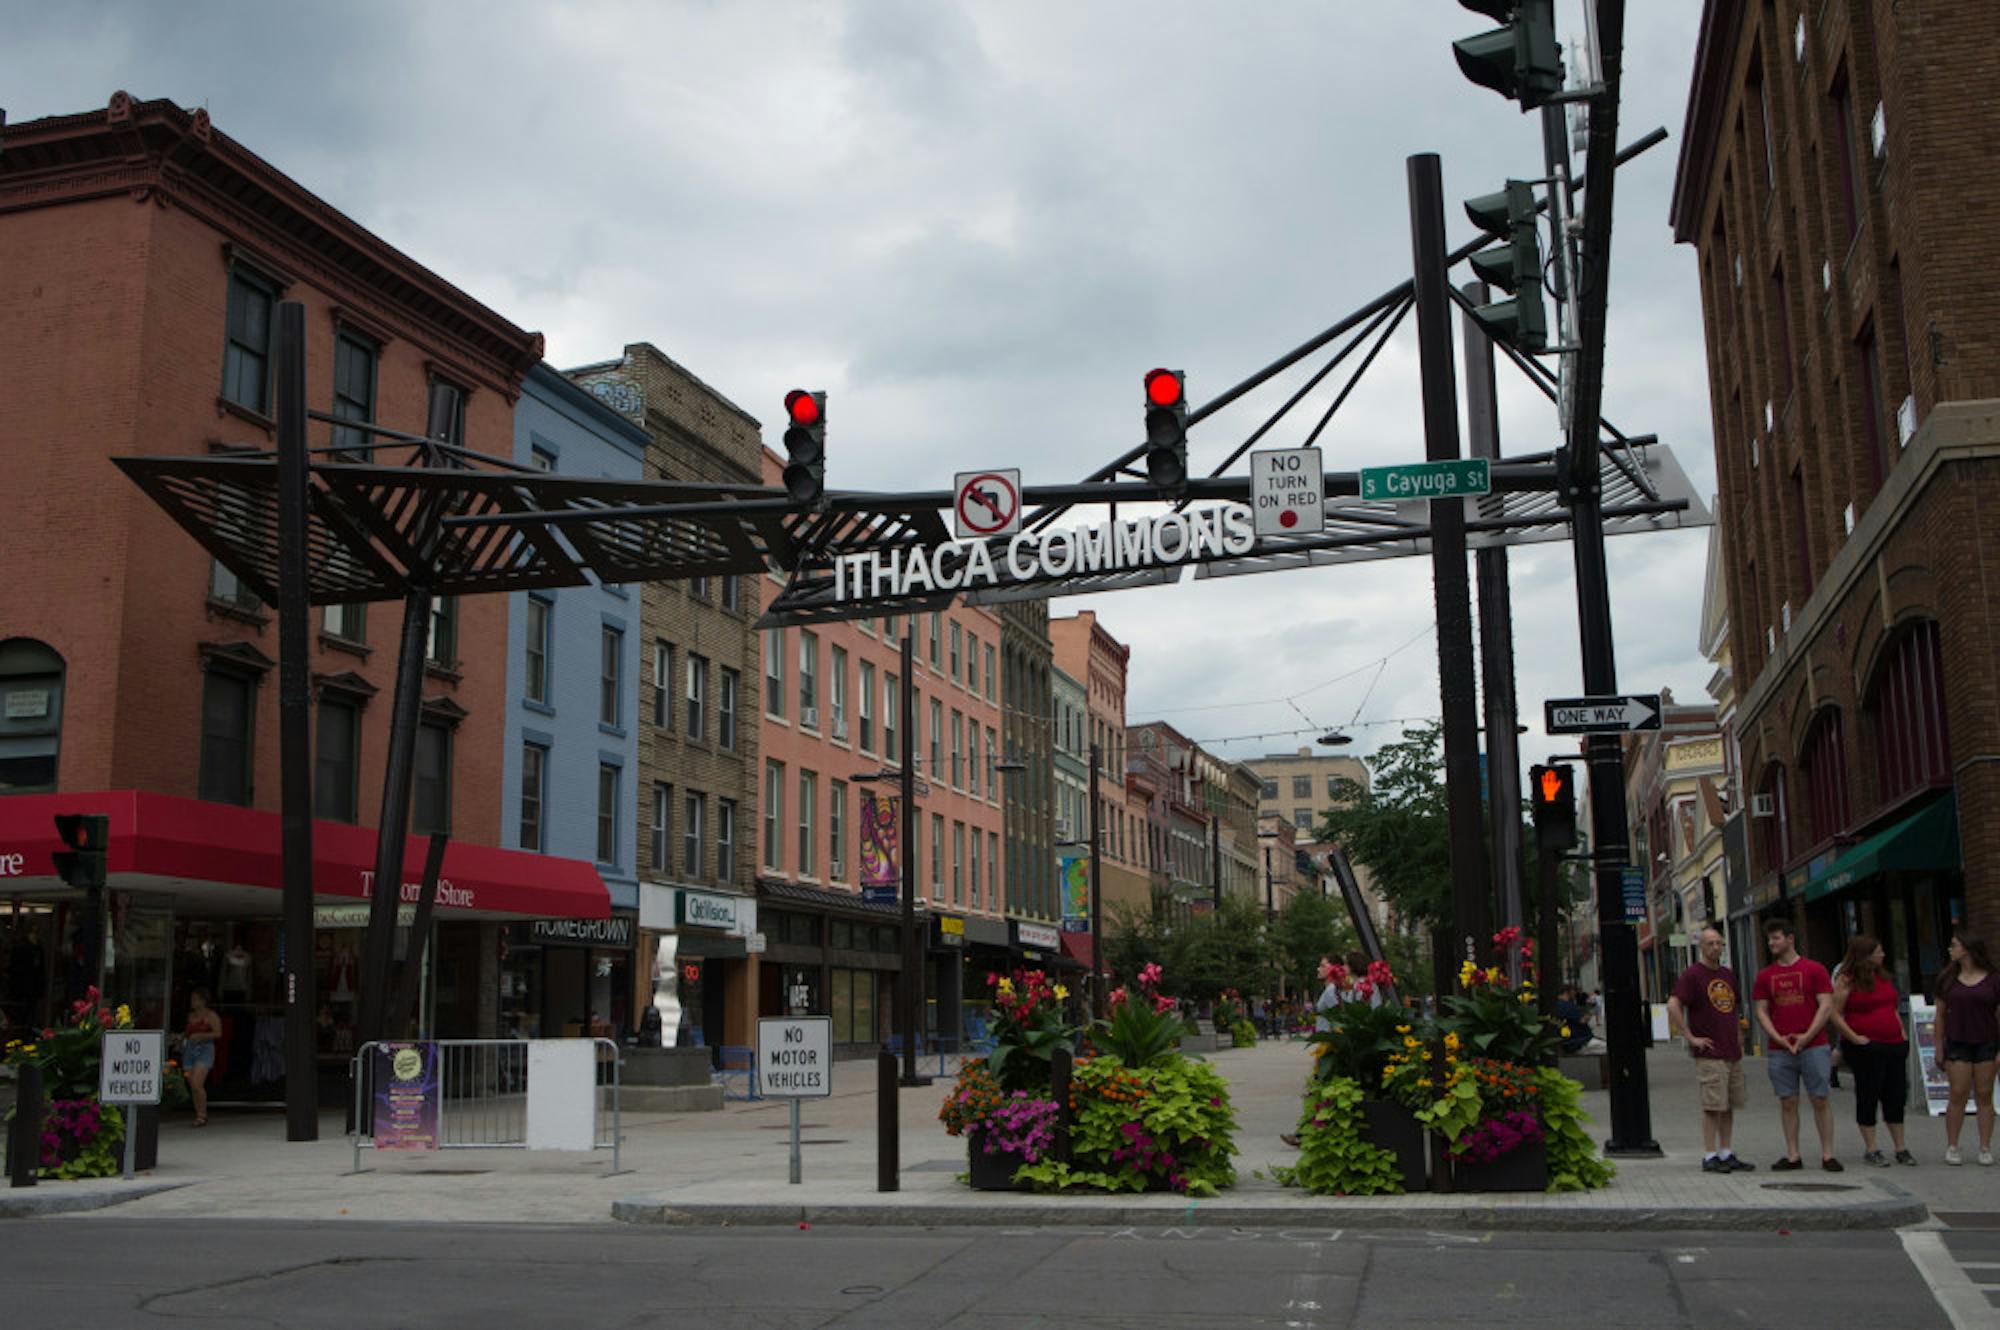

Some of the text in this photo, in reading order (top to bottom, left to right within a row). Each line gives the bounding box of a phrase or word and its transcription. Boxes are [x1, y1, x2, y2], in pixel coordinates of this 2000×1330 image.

[1271, 455, 1301, 472] NO
[1268, 475, 1307, 490] TURN
[1366, 471, 1484, 496] S Cayuga St
[1259, 492, 1317, 508] ON RED
[833, 503, 1256, 602] ITHACA COMMONS
[1557, 708, 1625, 724] ONE WAY
[785, 1027, 803, 1043] NO
[126, 1040, 141, 1055] NO
[771, 1050, 816, 1065] MOTOR
[113, 1060, 151, 1074] MOTOR
[109, 1080, 152, 1095] VEHICLES
[768, 1072, 820, 1088] VEHICLES
